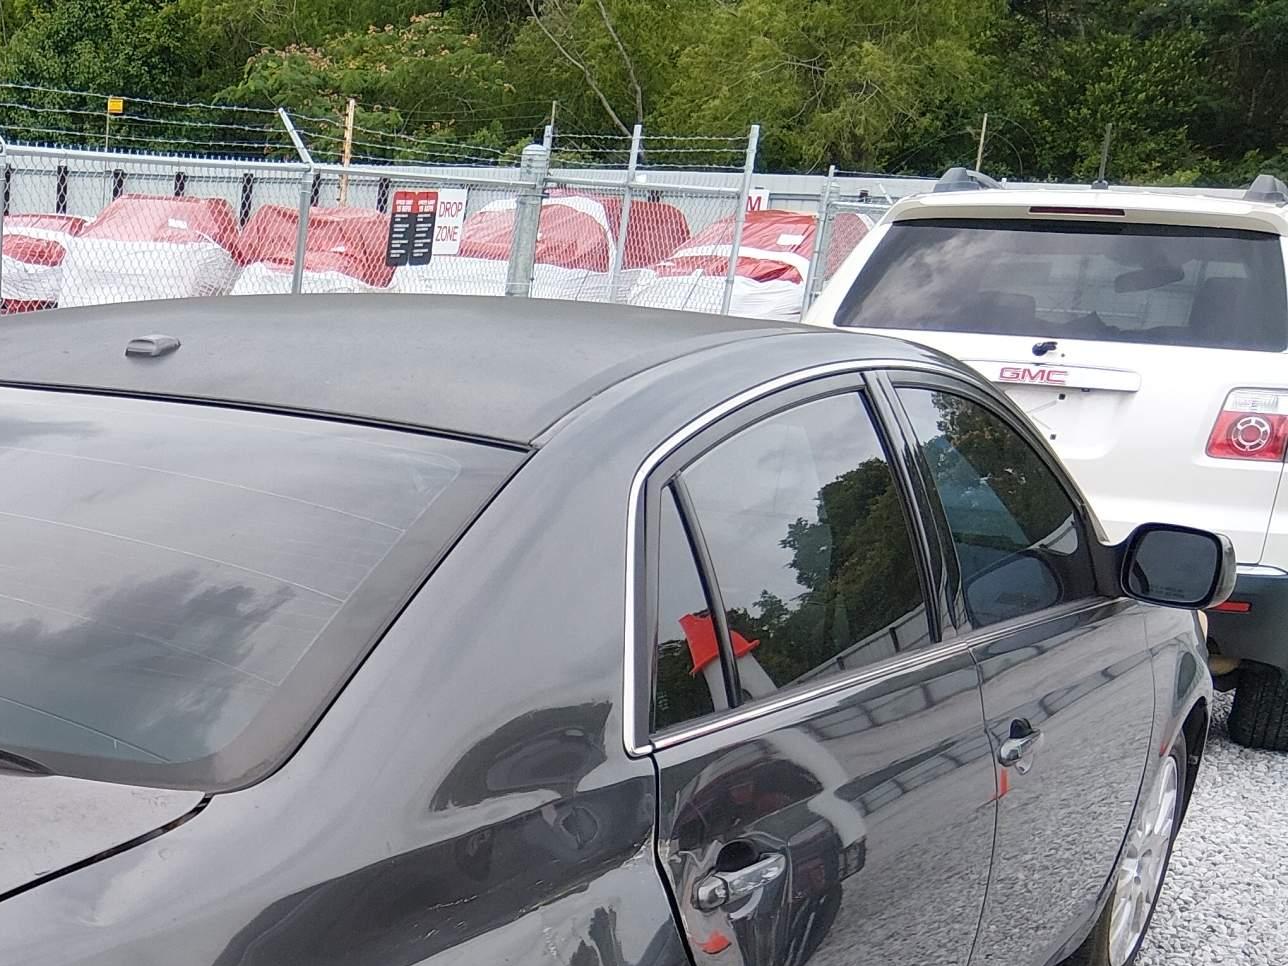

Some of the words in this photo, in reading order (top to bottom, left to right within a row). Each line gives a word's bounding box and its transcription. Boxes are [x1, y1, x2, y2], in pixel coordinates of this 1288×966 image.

[438, 201, 463, 218] DROP
[435, 226, 459, 242] ZONE
[999, 366, 1068, 385] GMC
